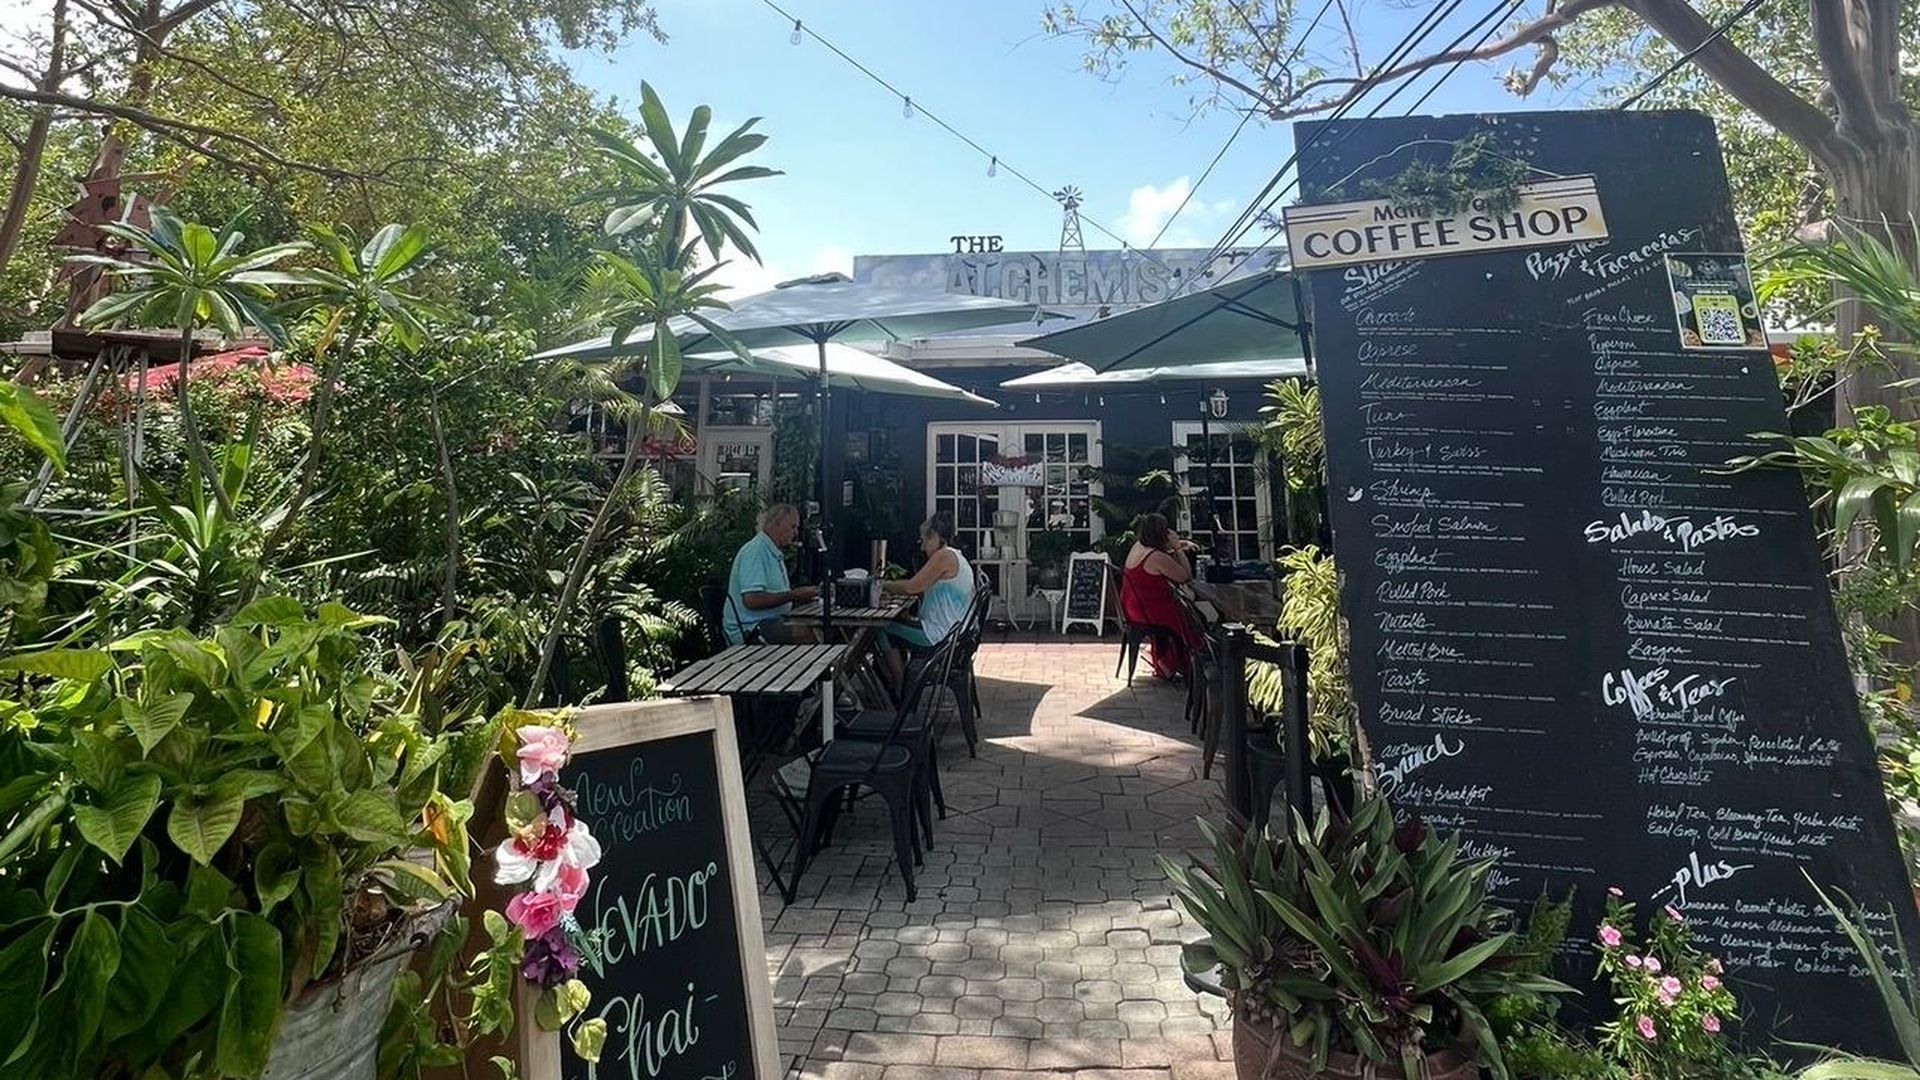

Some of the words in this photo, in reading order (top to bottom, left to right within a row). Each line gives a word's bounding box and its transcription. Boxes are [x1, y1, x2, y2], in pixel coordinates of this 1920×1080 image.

[1303, 219, 1460, 259] COFFEE
[1469, 205, 1588, 242] SHOP
[950, 235, 1003, 253] THE
[1360, 437, 1423, 463] Turkey
[1370, 479, 1435, 508] Shrimp
[1375, 546, 1454, 574] Eggplant
[1618, 558, 1659, 576] House
[1664, 560, 1705, 576] Salad
[1420, 581, 1451, 600] Pork
[1672, 588, 1711, 603] Salad
[1374, 611, 1435, 630] Nutella
[1683, 617, 1722, 632] Salad
[1377, 640, 1428, 660] Melted
[573, 757, 682, 817] New
